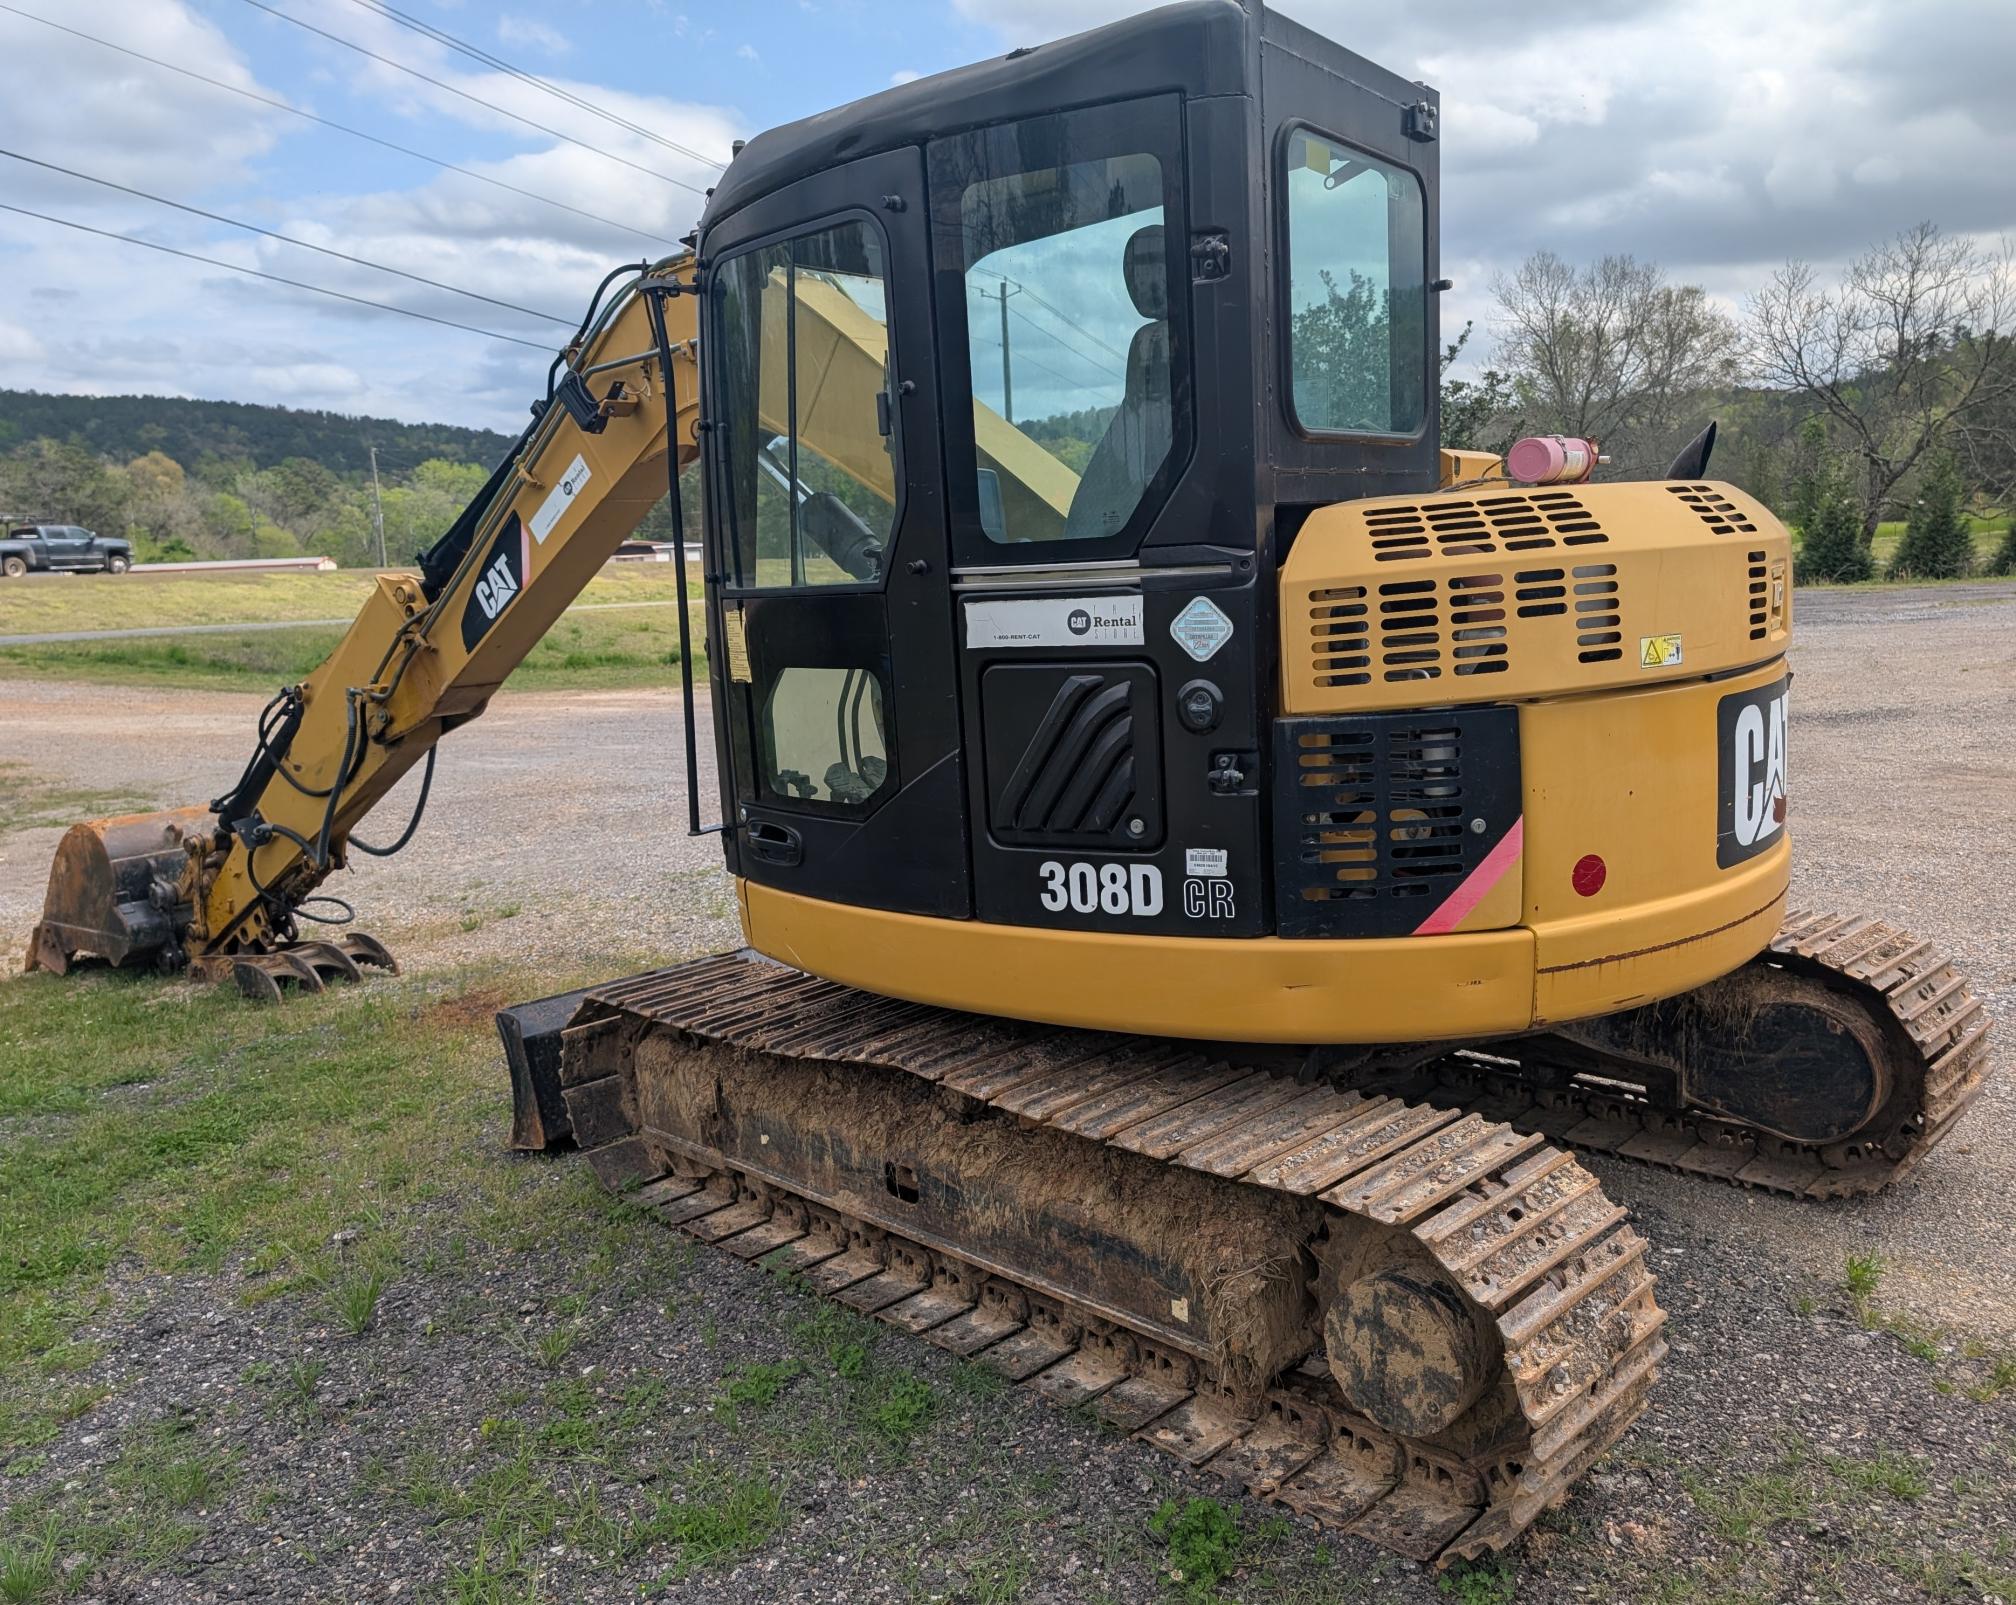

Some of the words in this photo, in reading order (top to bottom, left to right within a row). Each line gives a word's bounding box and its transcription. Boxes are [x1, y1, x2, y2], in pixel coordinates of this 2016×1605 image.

[475, 553, 518, 619] CAT
[1070, 616, 1087, 629] CAT
[1093, 615, 1137, 628] Rental
[1039, 860, 1164, 917] 308D
[1183, 878, 1235, 918] CR
